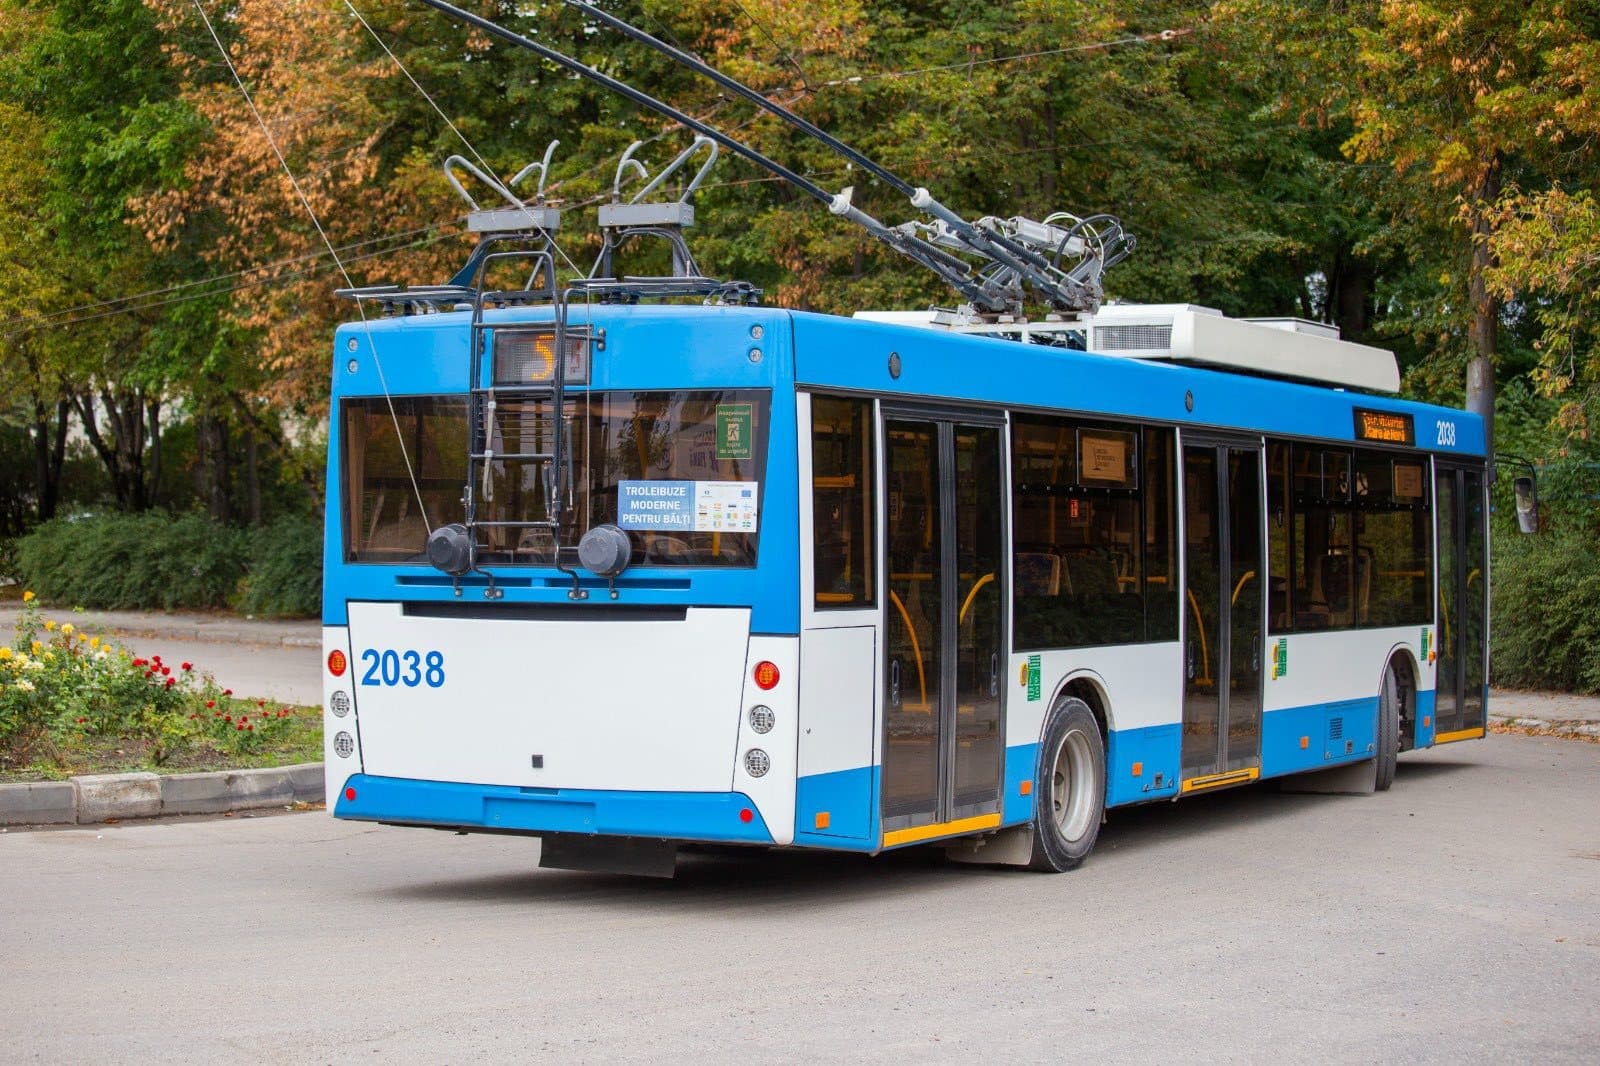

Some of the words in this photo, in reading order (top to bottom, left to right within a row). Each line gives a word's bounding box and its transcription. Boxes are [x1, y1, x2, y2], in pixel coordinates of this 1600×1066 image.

[531, 335, 554, 380] 5
[1436, 420, 1455, 446] 2038
[625, 486, 686, 497] TROLEIBUZE
[630, 500, 681, 510] MODERNE
[622, 514, 661, 524] PENTRU
[361, 648, 445, 688] 2038
